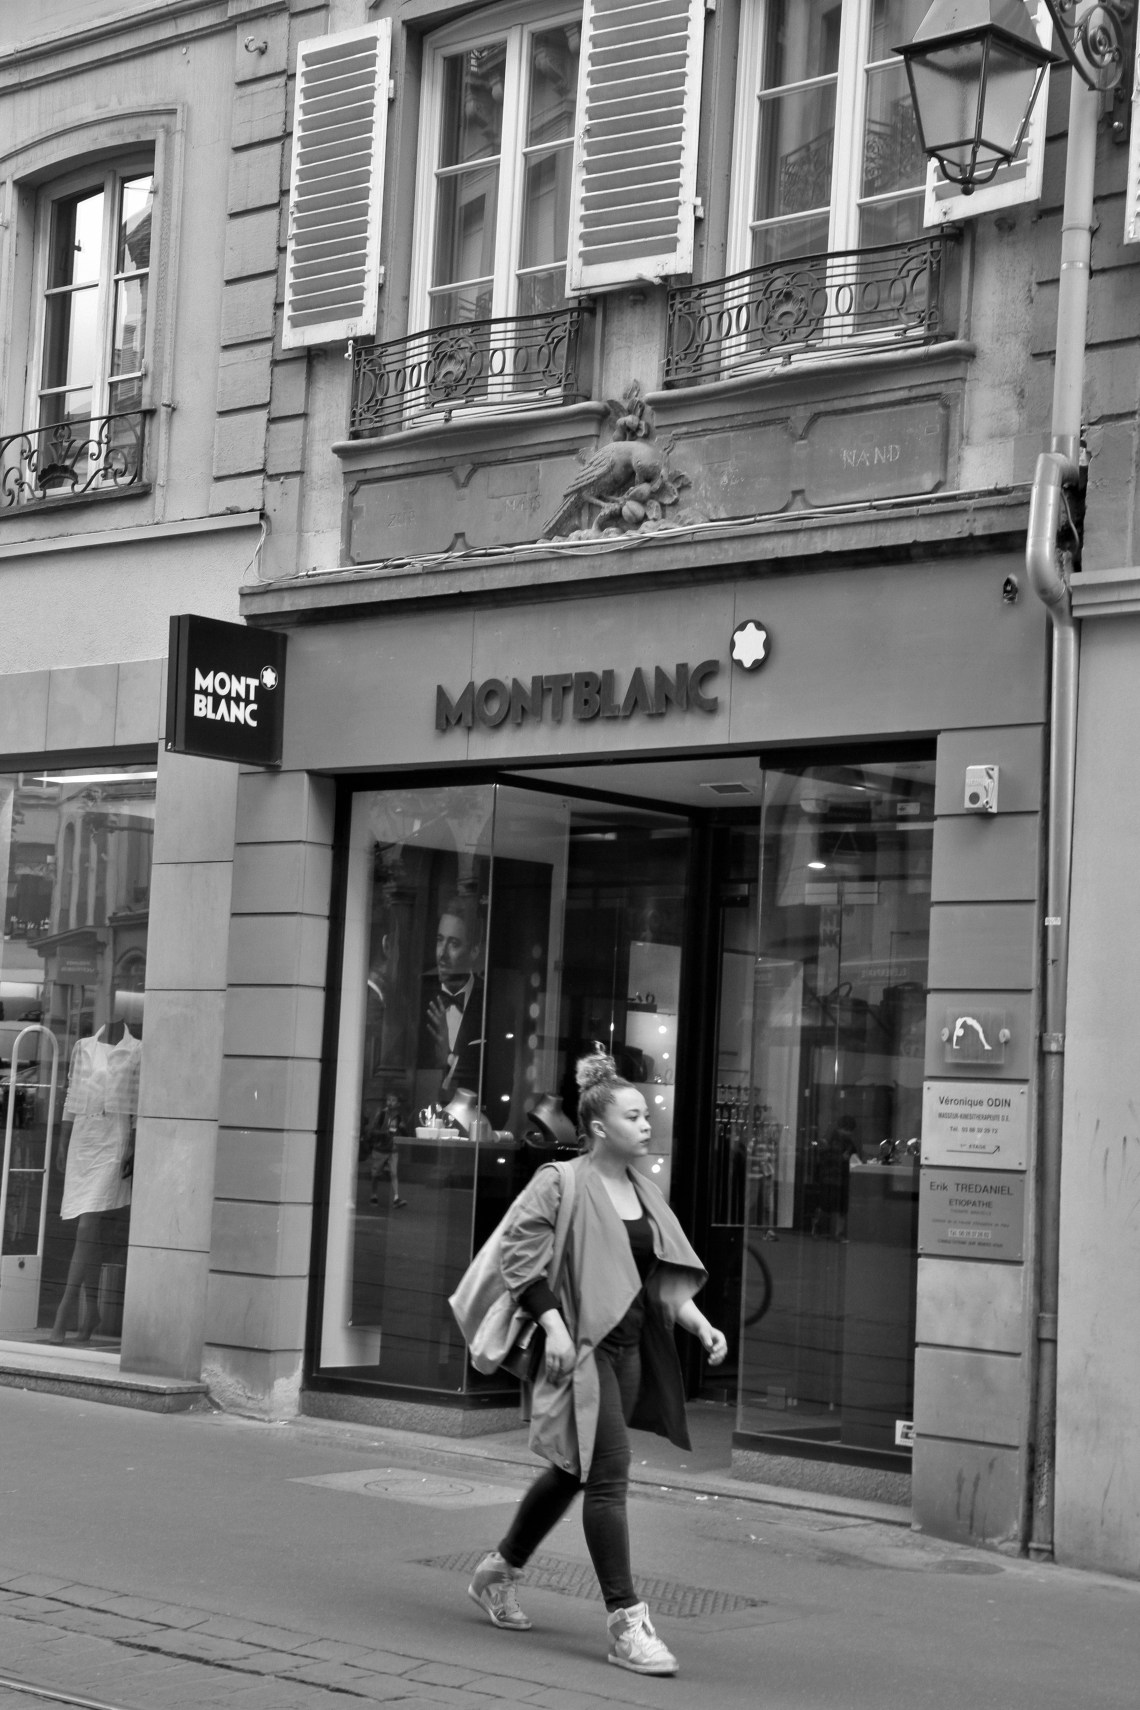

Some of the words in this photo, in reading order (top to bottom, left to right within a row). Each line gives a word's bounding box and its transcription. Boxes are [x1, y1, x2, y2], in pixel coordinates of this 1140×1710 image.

[195, 667, 260, 701] MONT
[435, 660, 720, 730] MONTBLANC
[193, 693, 258, 727] BLANC
[939, 1096, 984, 1108] Véronique
[986, 1097, 1011, 1108] ODIN
[930, 1181, 948, 1191] Erik
[954, 1183, 1014, 1196] TREDANIEL
[949, 1199, 993, 1209] ETIOPATHE
